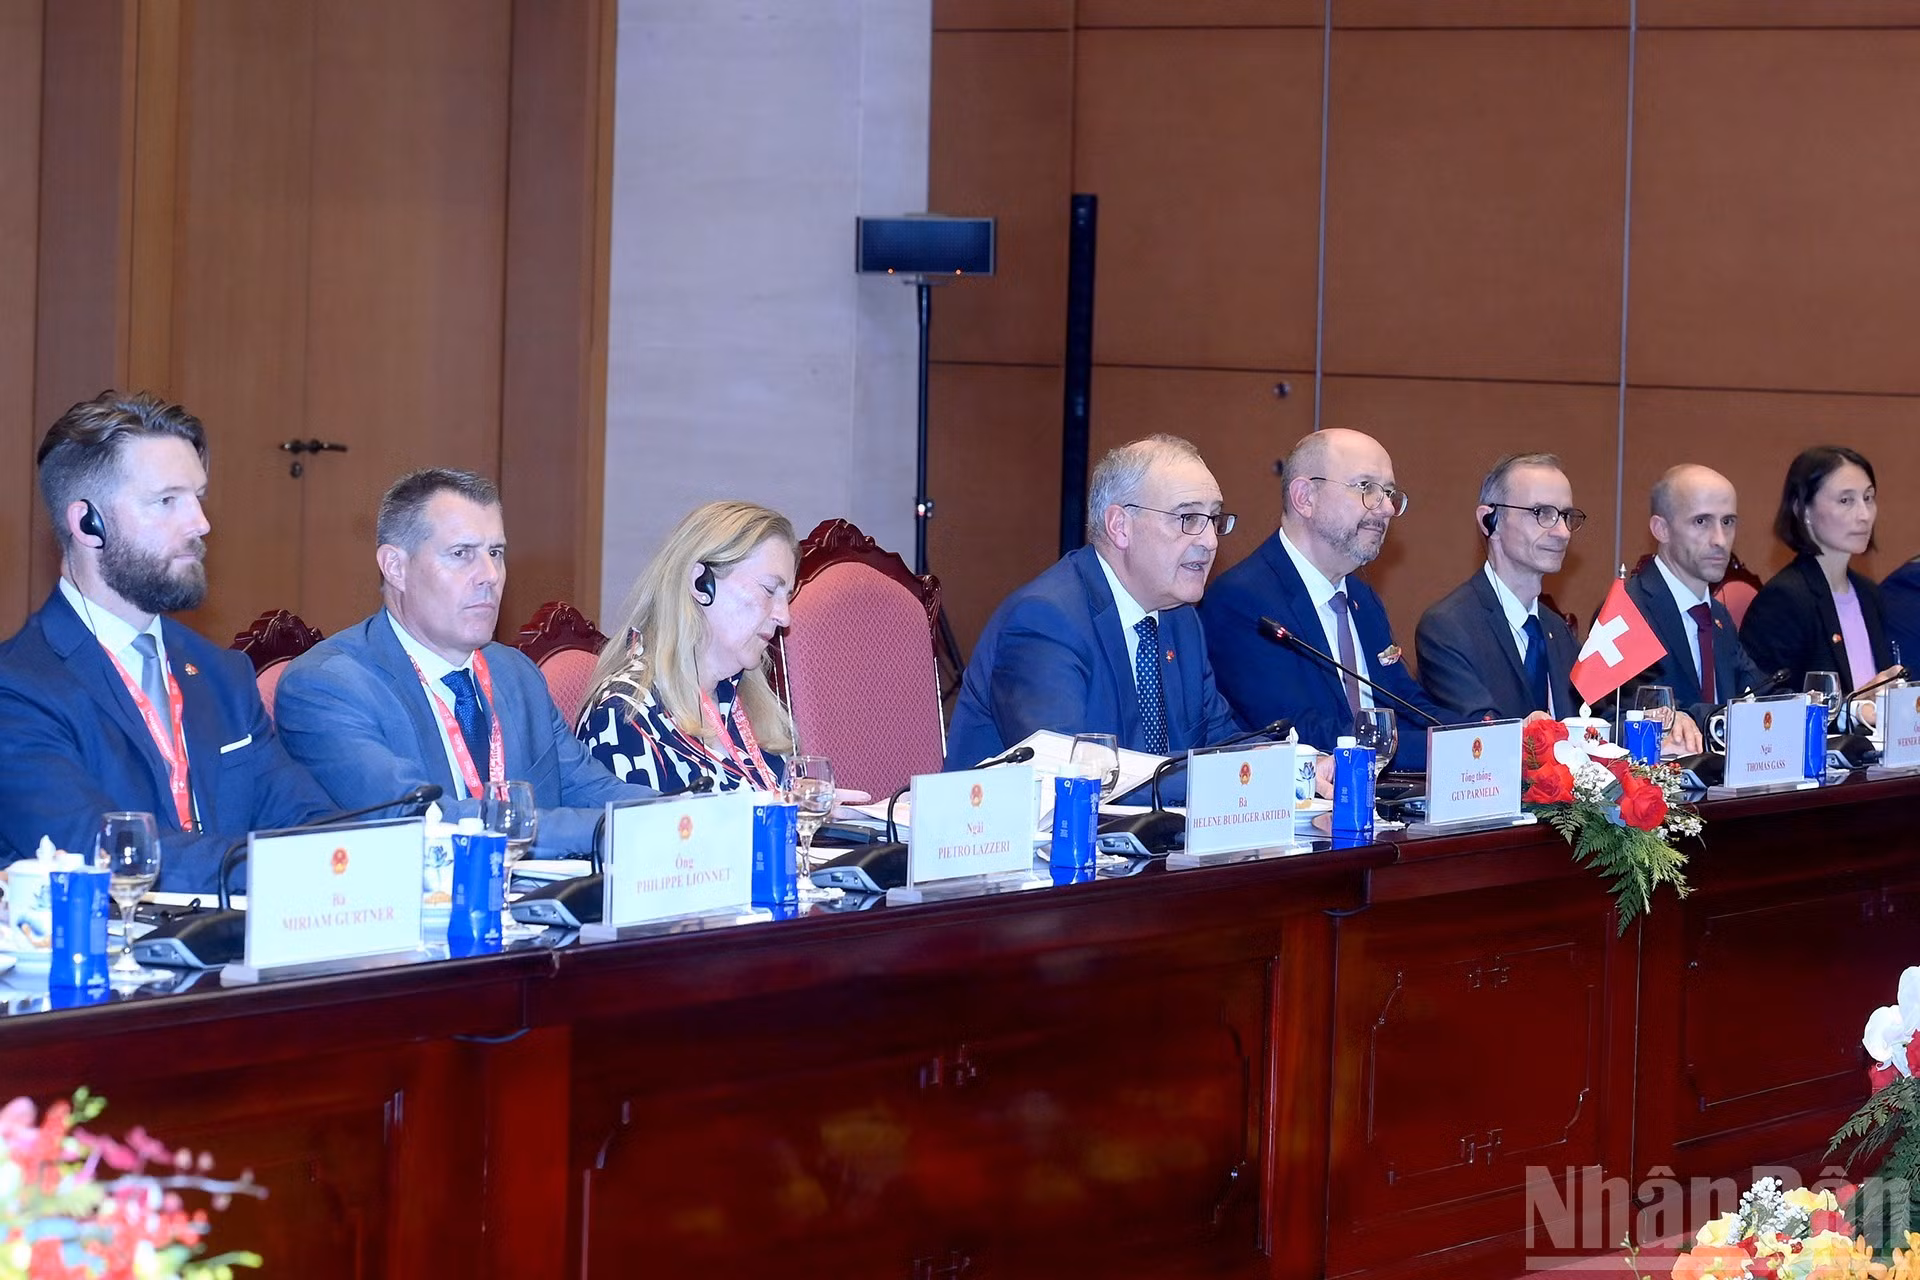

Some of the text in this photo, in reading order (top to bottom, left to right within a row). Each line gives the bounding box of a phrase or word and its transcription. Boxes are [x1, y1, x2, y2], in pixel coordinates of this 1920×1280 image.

[1746, 759, 1786, 772] THOMAS GASS
[1451, 786, 1500, 802] GUY PARMELIN
[1193, 808, 1291, 828] HELENE BUDLIGER ARTIEDA
[938, 840, 1010, 860] PIETRO LAZZERI
[675, 852, 694, 871] Ông
[636, 867, 731, 894] PHILIPPE LIONNET
[282, 905, 394, 932] MIRIAM GURTNER
